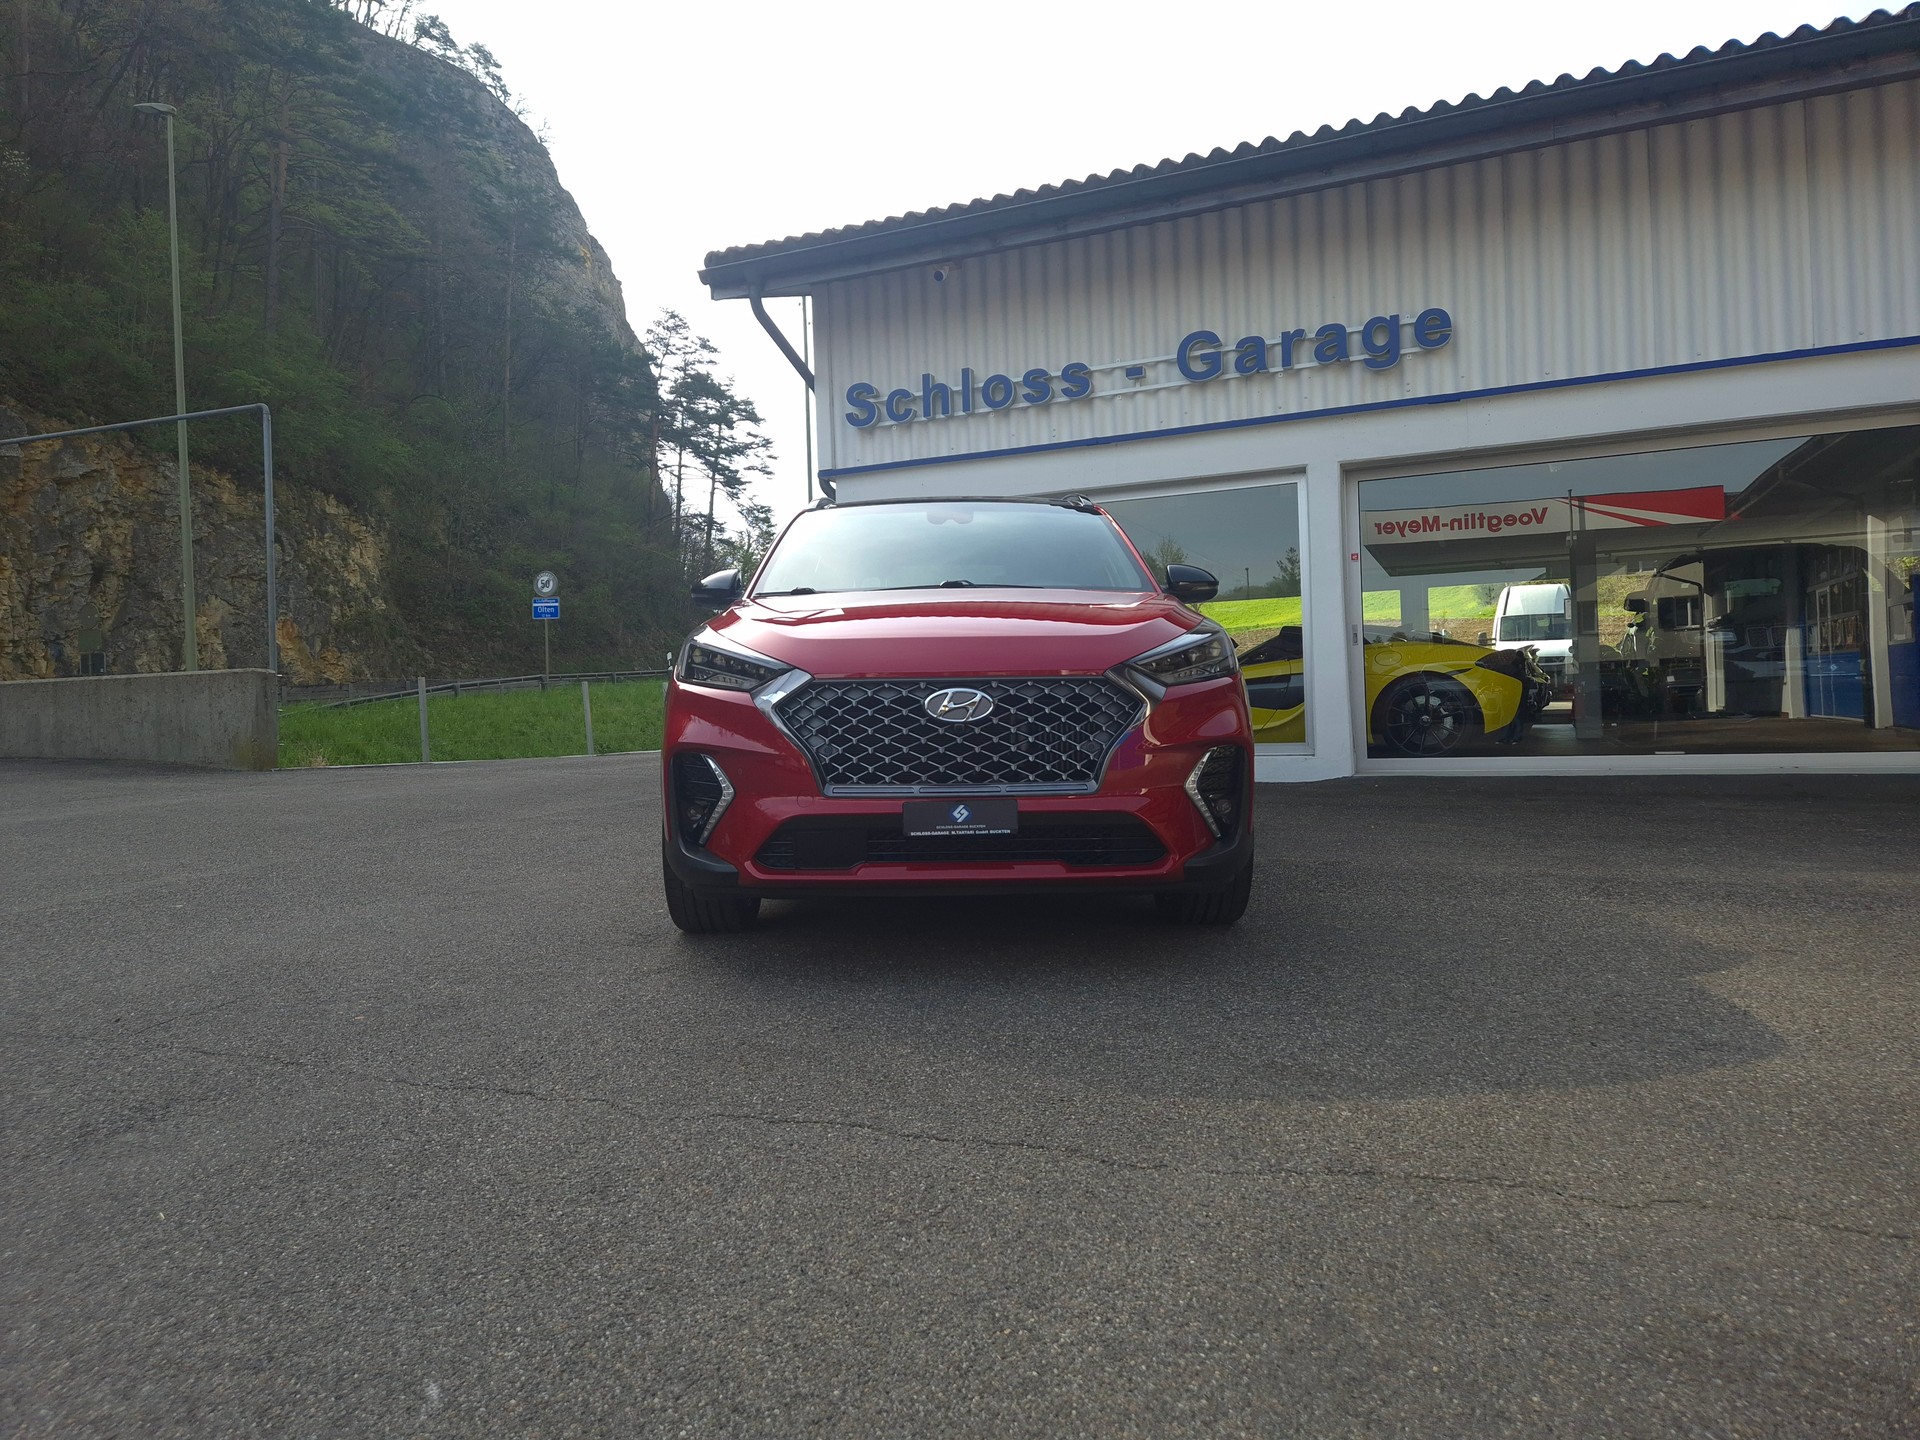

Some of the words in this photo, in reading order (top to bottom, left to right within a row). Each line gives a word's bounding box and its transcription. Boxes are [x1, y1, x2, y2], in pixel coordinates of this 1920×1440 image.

[845, 361, 1093, 430] Schloss
[1176, 306, 1453, 384] Garage
[540, 579, 550, 589] 50
